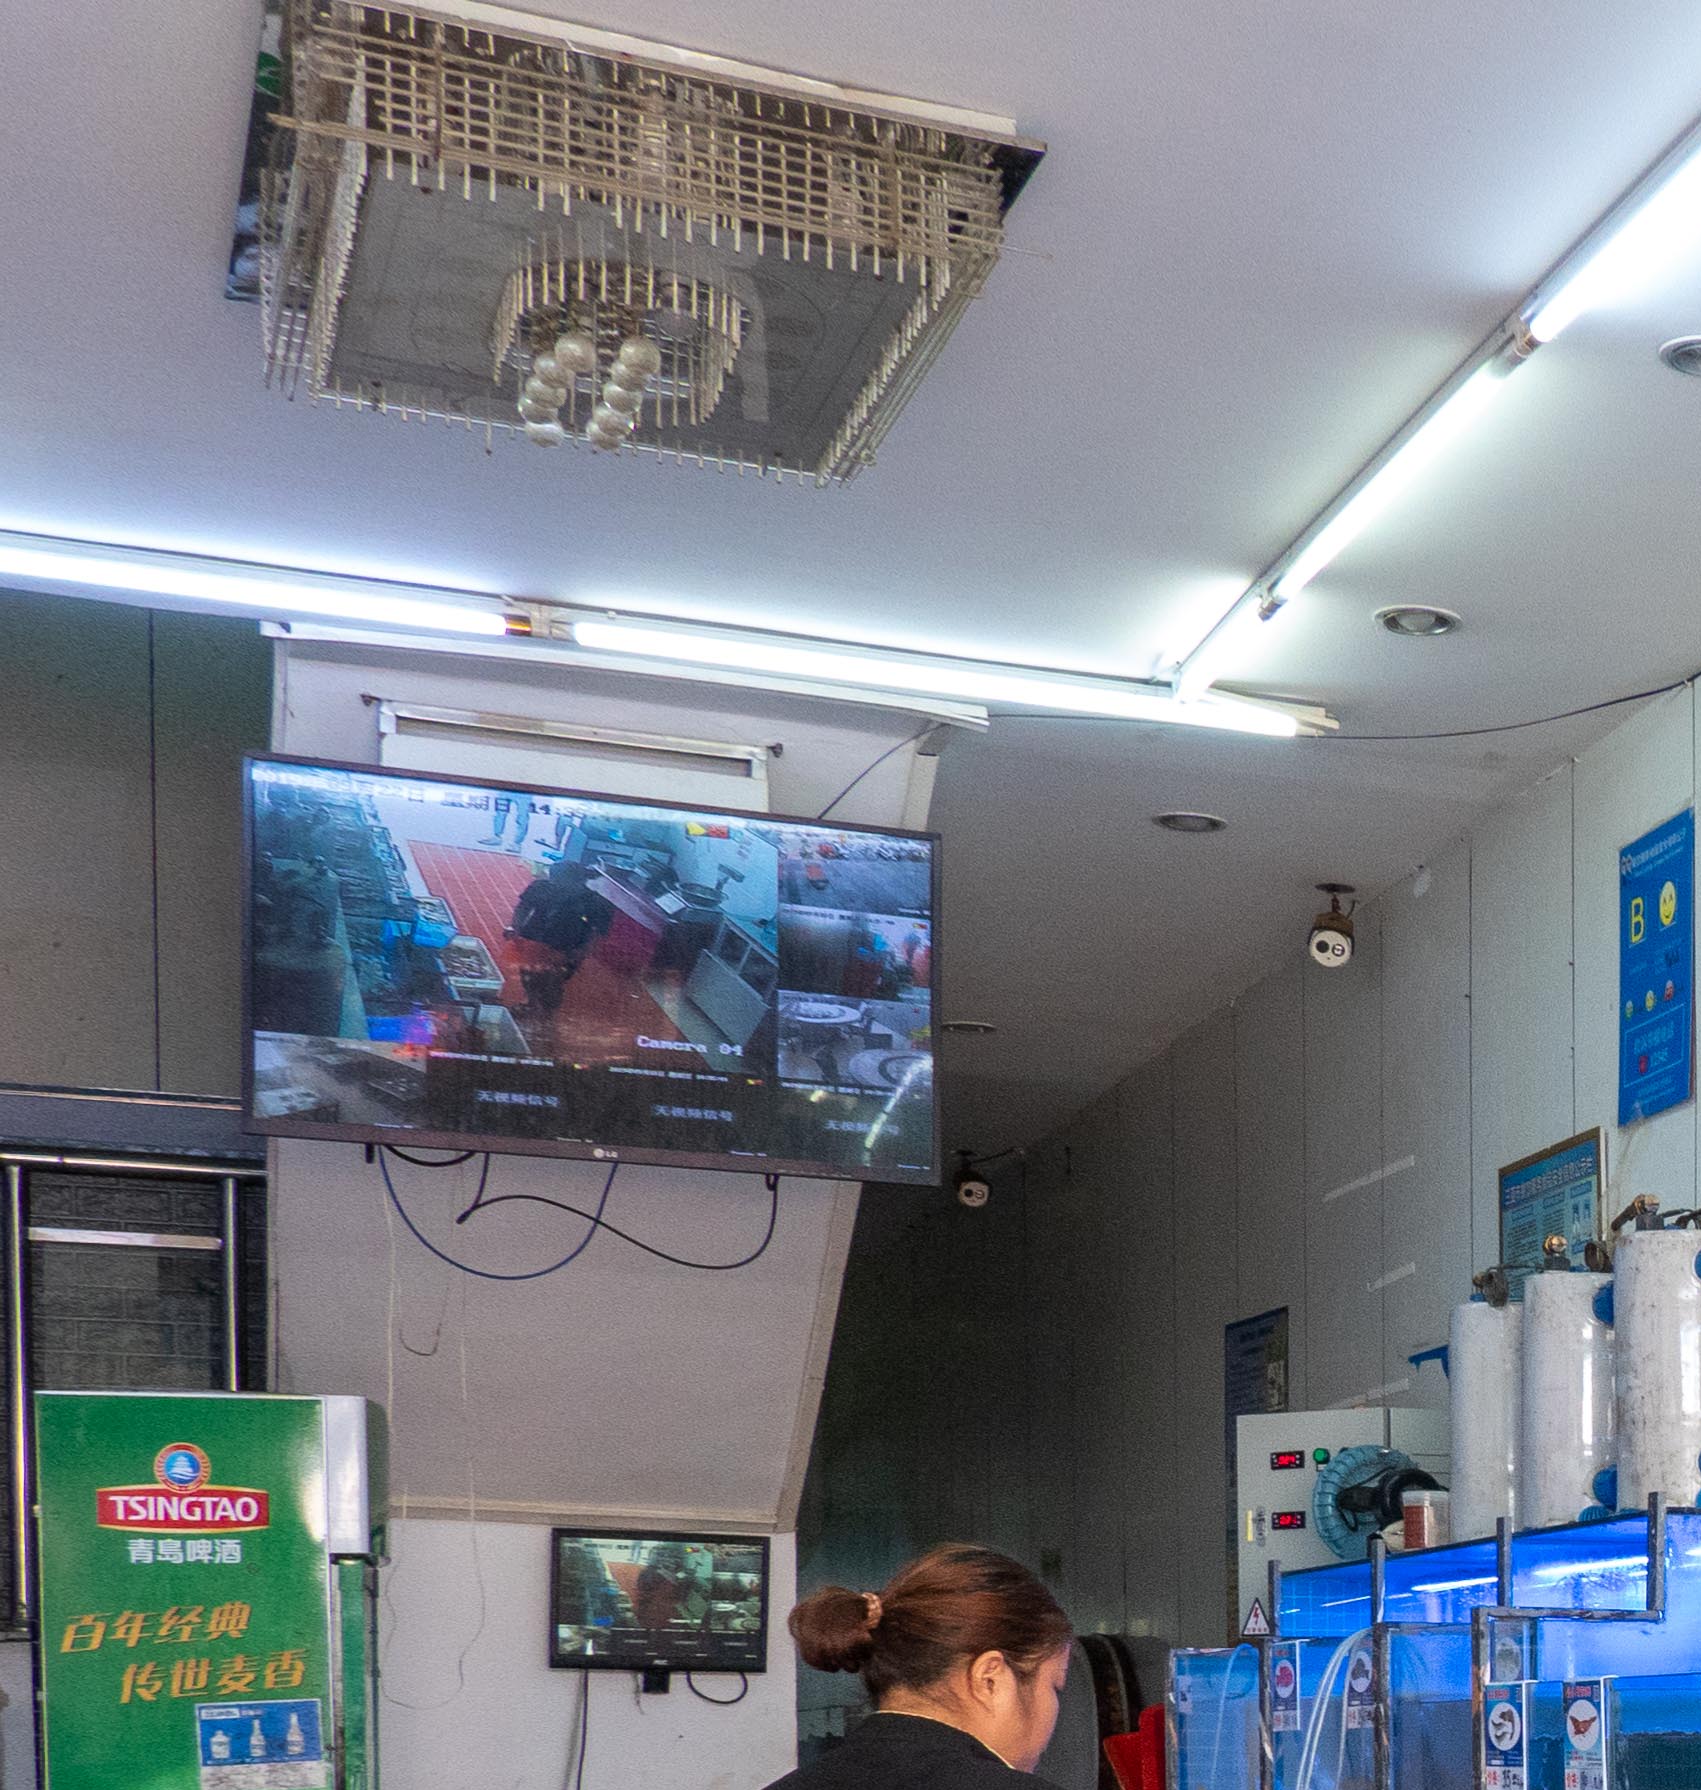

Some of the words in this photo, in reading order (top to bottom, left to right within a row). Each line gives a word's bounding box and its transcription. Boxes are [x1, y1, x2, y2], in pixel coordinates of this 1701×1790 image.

[1630, 897, 1644, 944] B
[109, 1496, 258, 1522] TSINGTAO
[126, 1540, 242, 1565] 青岛啤酒
[60, 1602, 251, 1655] 百年经典
[119, 1650, 307, 1703] 传世麦香
